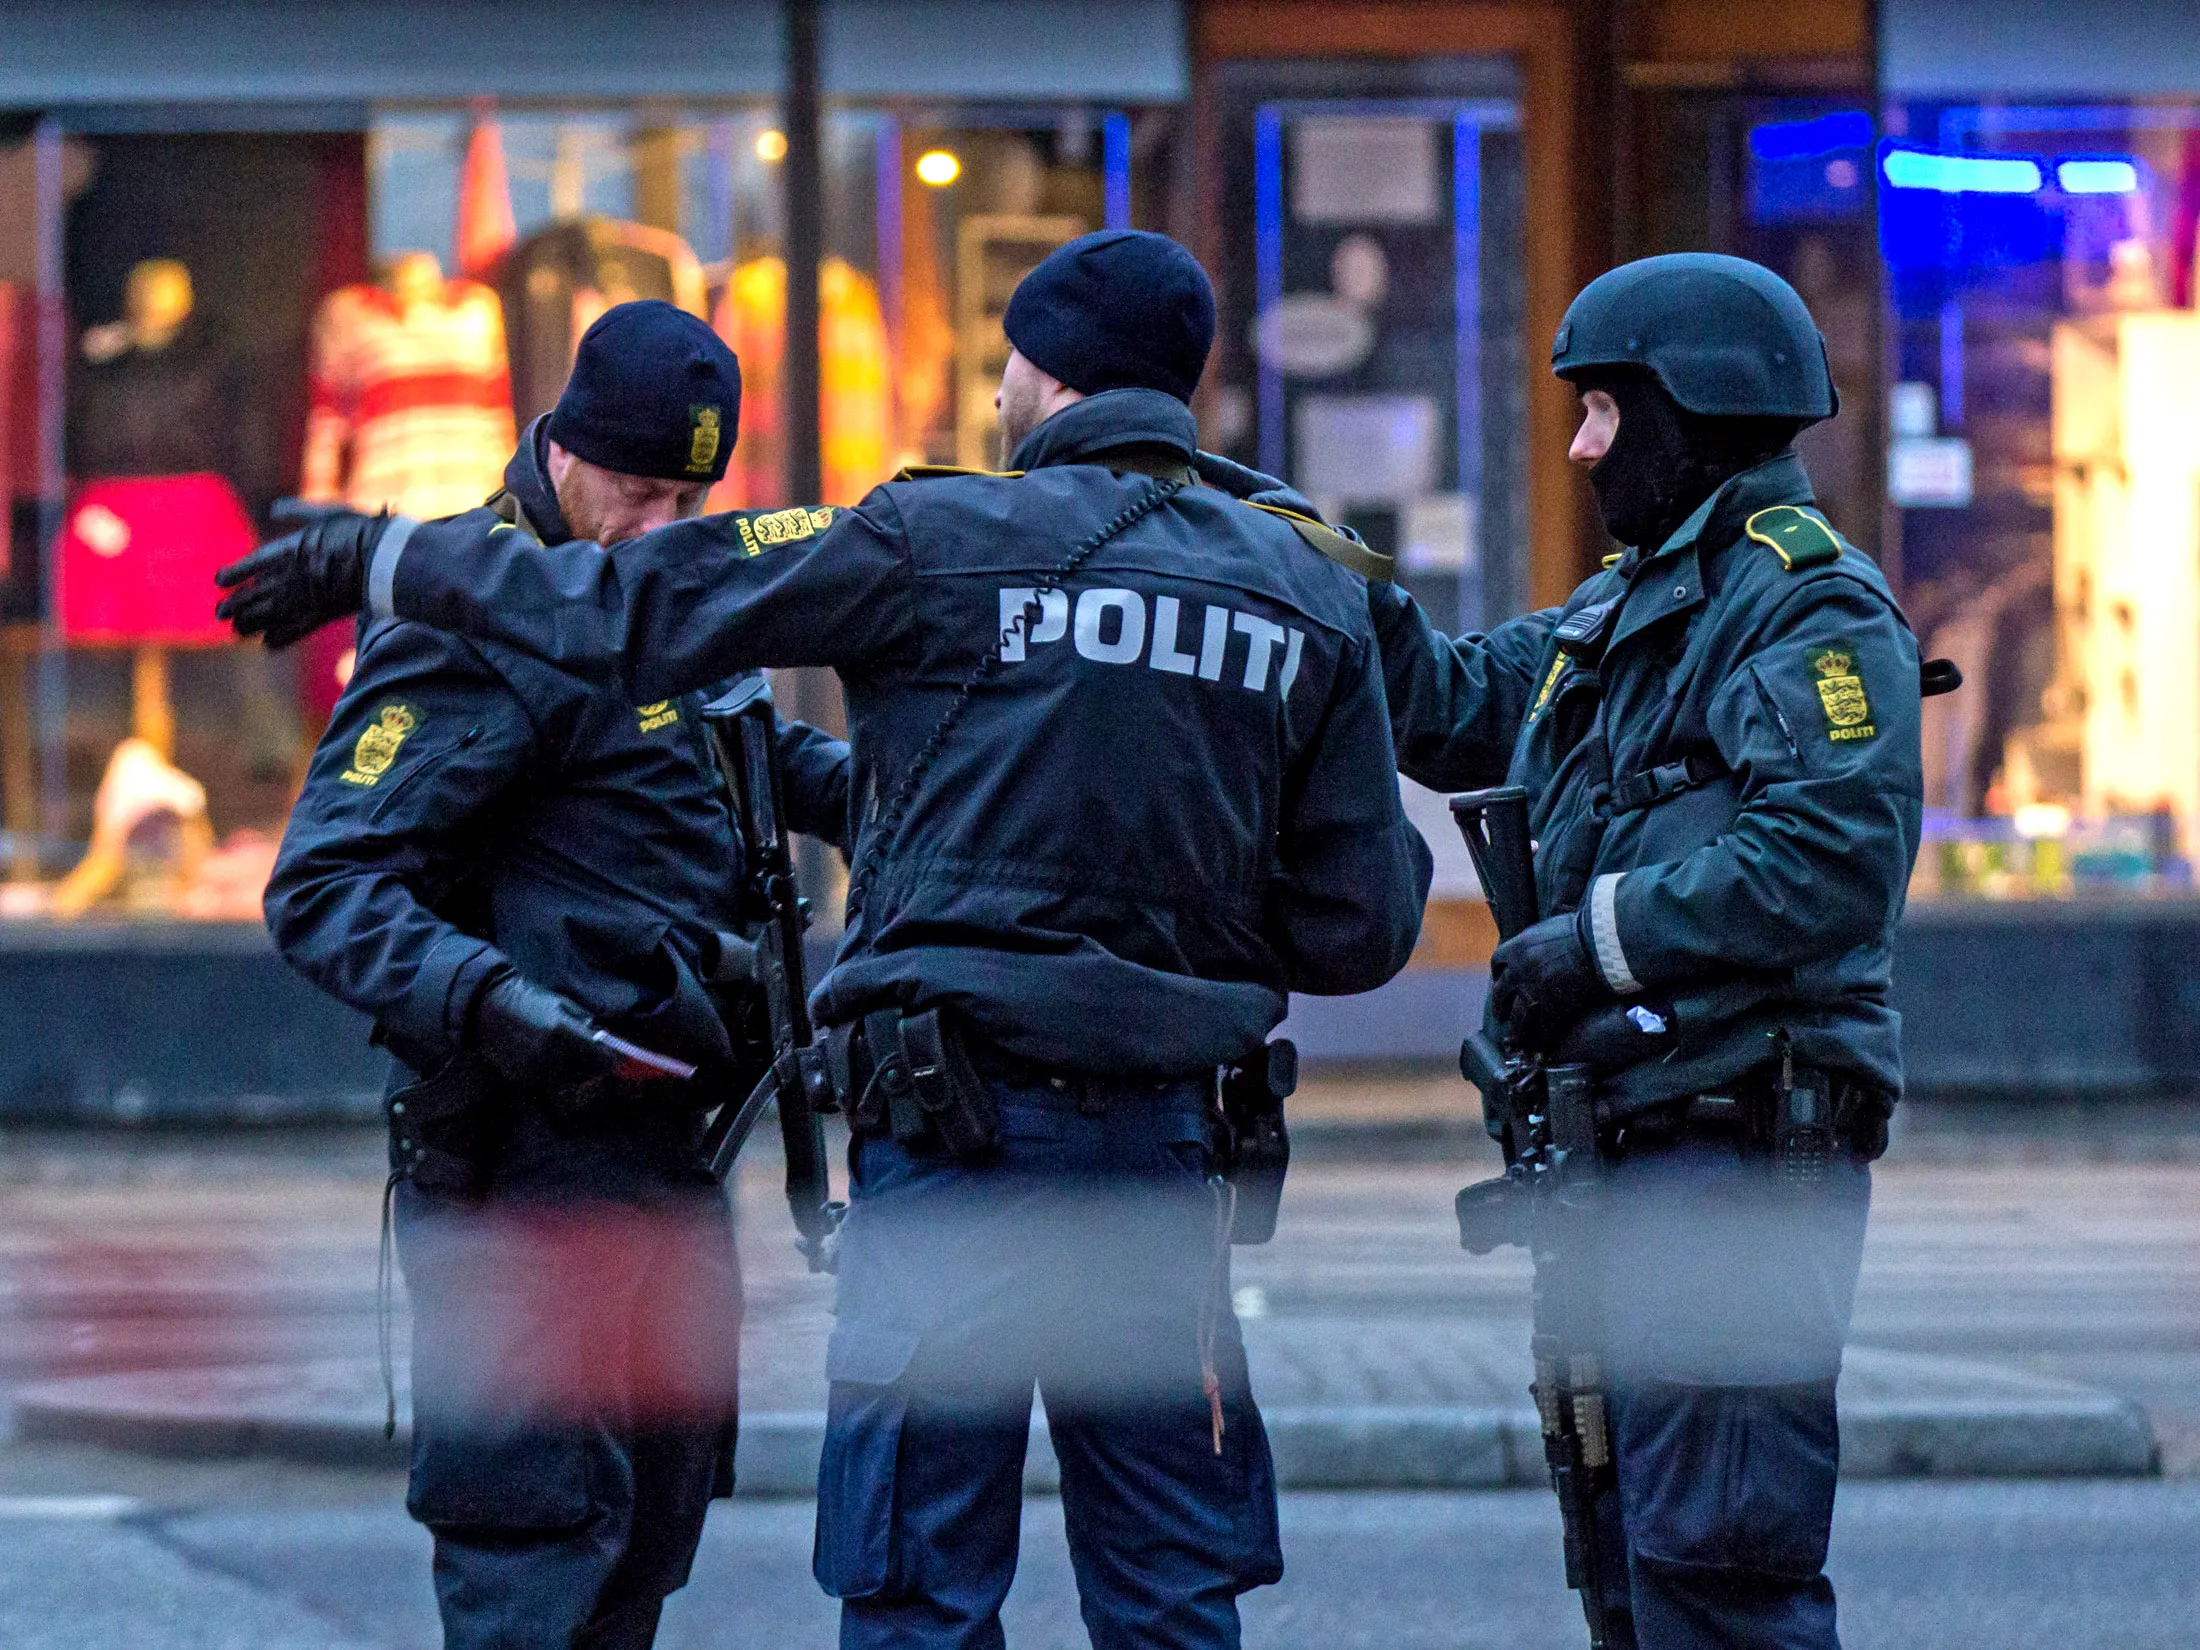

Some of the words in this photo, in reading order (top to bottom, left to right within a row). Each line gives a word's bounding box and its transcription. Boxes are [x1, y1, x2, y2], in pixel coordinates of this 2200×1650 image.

[736, 517, 761, 557] POLITI
[999, 588, 1305, 700] POLITI
[640, 709, 678, 733] POLITI
[1829, 725, 1875, 741] POLITI
